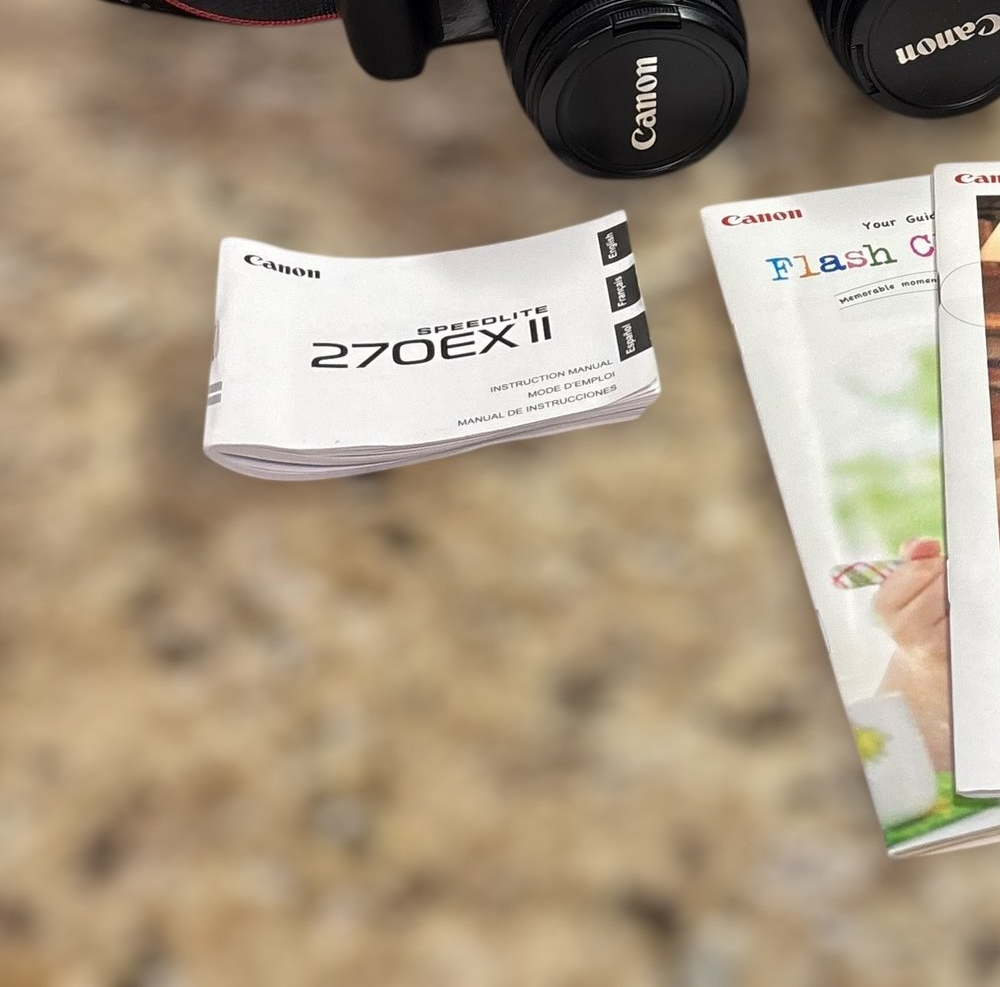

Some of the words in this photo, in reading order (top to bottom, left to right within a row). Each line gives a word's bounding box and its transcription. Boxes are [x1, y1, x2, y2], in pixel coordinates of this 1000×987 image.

[631, 56, 658, 150] Canon
[721, 208, 803, 227] Canon
[862, 219, 897, 230] Your
[604, 231, 618, 260] English
[765, 243, 898, 282] Flash
[909, 233, 936, 258] C
[243, 254, 321, 279] Canon
[613, 275, 628, 308] Français
[838, 283, 896, 305] Memorable
[417, 304, 549, 336] SPEEDLITE
[311, 328, 520, 370] 270EX
[528, 316, 552, 343] II
[622, 323, 637, 355] Español
[489, 370, 566, 393] INSTRUCTION
[568, 359, 614, 375] MANUAL
[527, 384, 562, 399] MODE
[563, 371, 616, 390] D'EMPLOI
[457, 412, 505, 427] MANUAL
[507, 407, 524, 417] DE
[525, 384, 618, 413] INSTRUCCIONES
